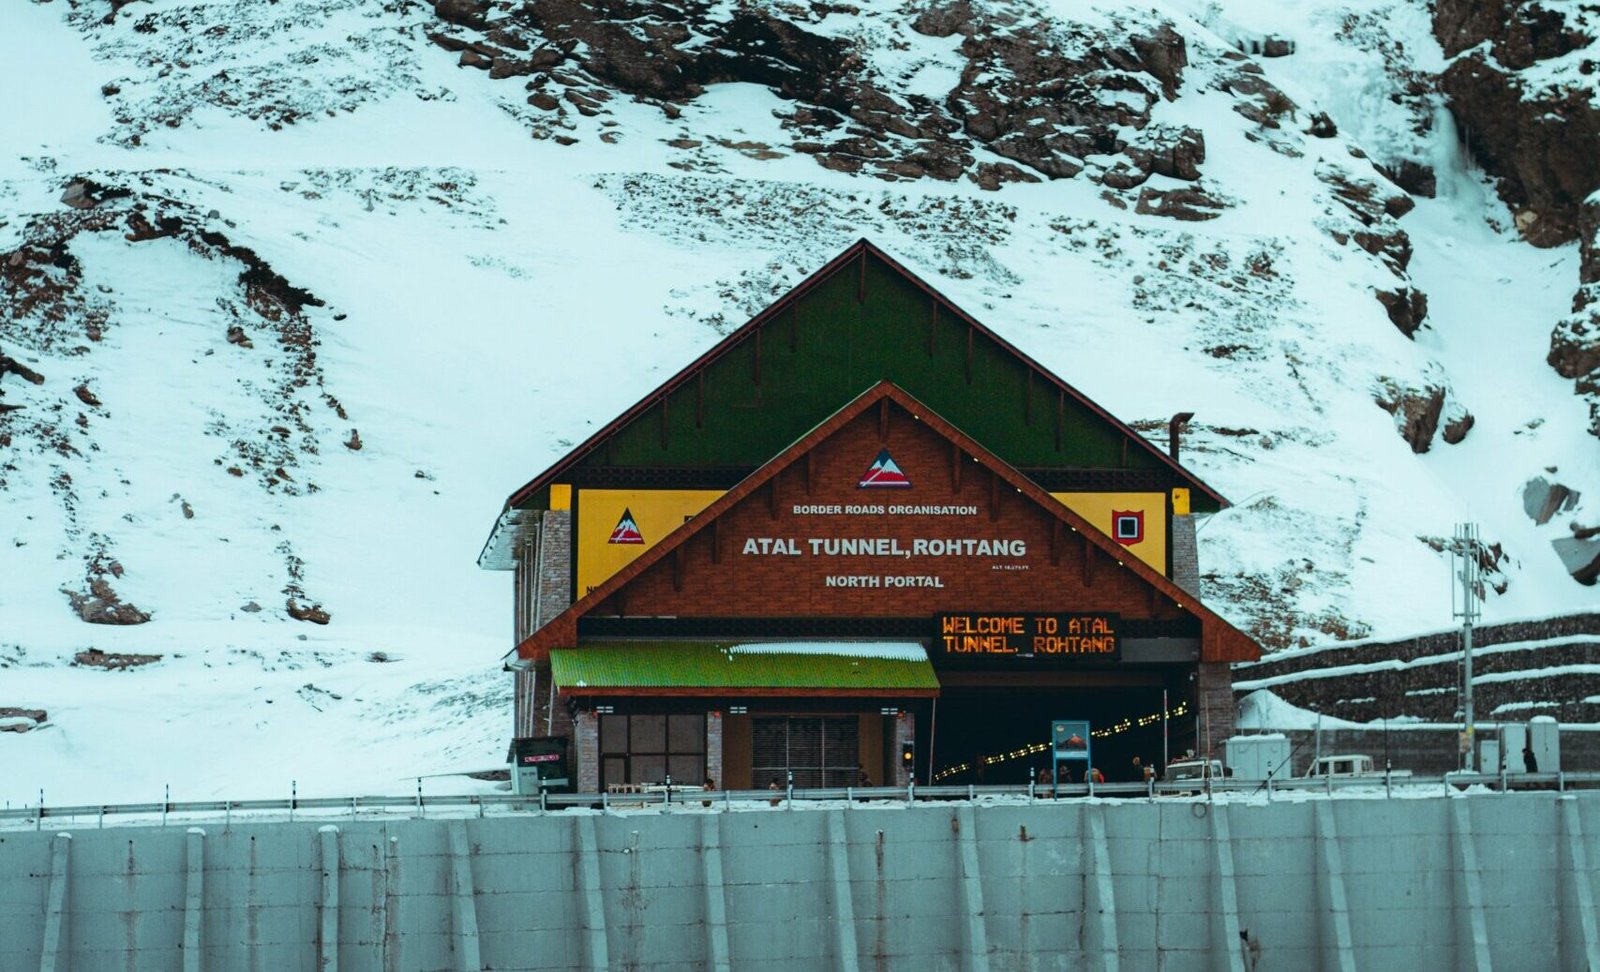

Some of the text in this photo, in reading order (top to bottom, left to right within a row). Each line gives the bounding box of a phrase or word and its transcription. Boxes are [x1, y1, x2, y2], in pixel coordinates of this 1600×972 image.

[792, 504, 977, 516] BORDER ROADS ORGANISATION
[743, 538, 801, 555] ATAL
[825, 575, 944, 588] NORTH PORTAL
[942, 616, 1115, 634] WELCOME TO ATAL
[1034, 636, 1115, 653] ROHTANG
